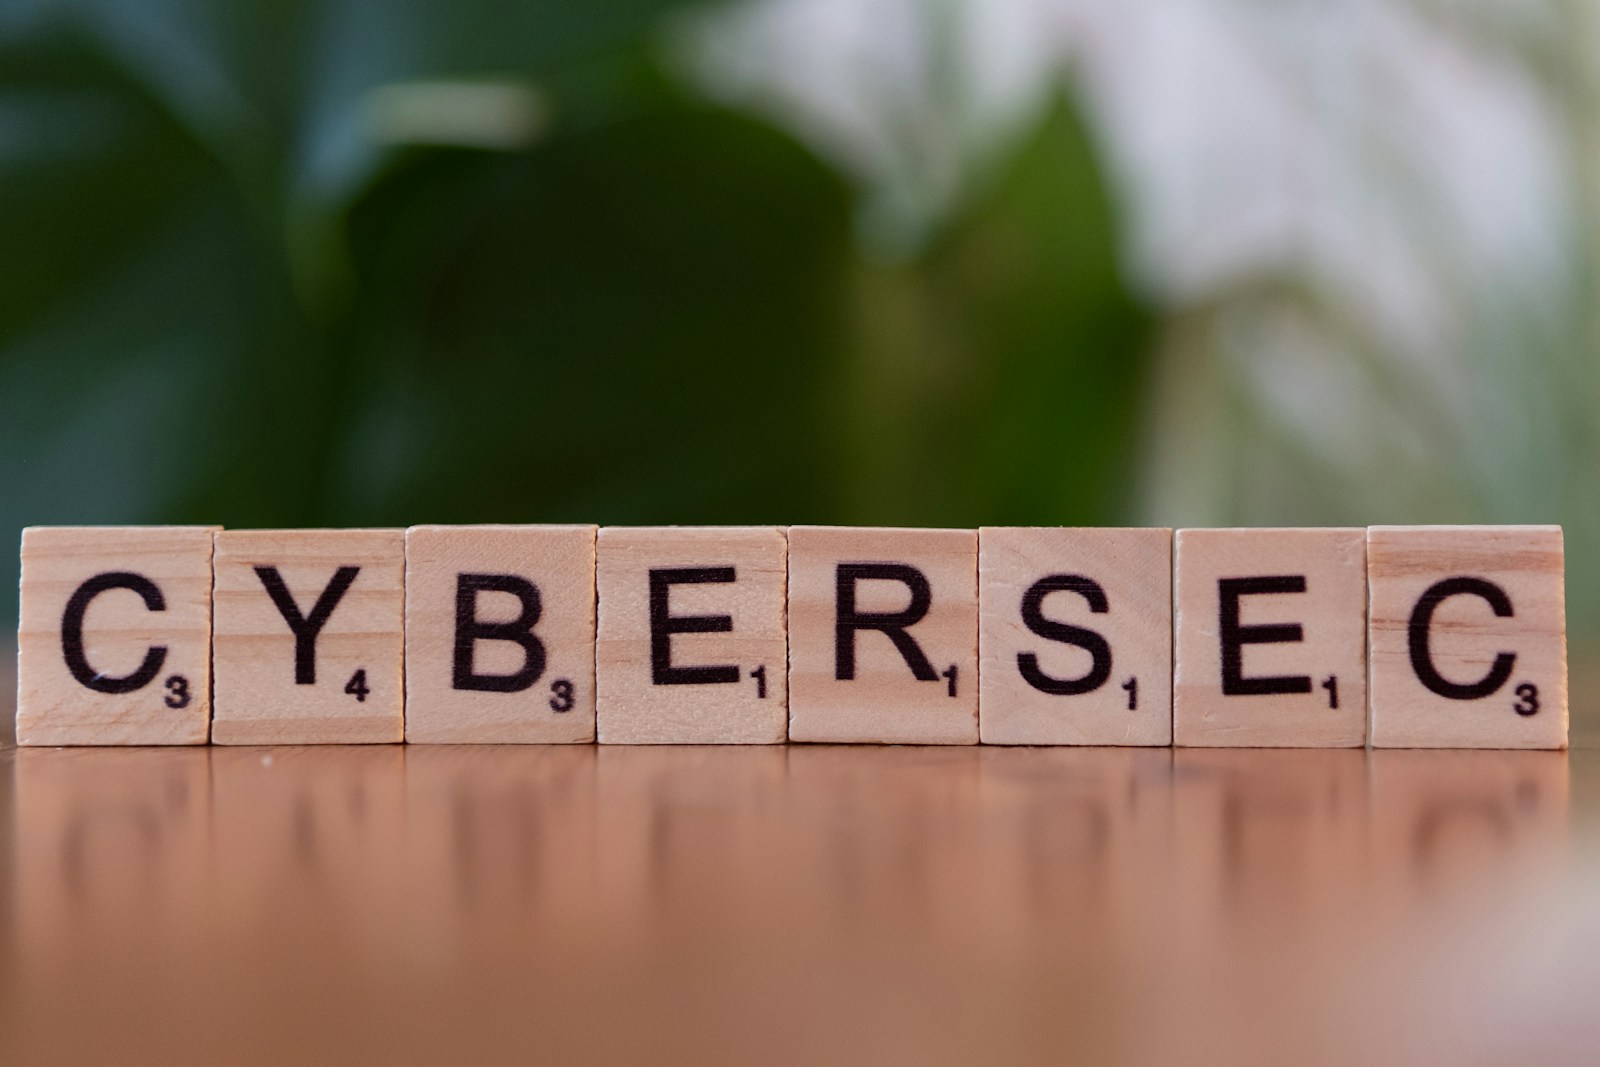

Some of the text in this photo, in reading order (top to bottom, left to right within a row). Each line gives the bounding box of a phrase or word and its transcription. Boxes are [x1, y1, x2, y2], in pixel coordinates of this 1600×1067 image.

[60, 563, 1517, 701] CYBERSEC
[165, 676, 191, 709] 3
[344, 669, 371, 703] 4
[549, 680, 576, 714] 3
[749, 665, 767, 699] 1
[942, 664, 959, 698] 1
[1121, 677, 1138, 711] 1
[1321, 675, 1339, 710] 1
[1513, 682, 1541, 718] 3
